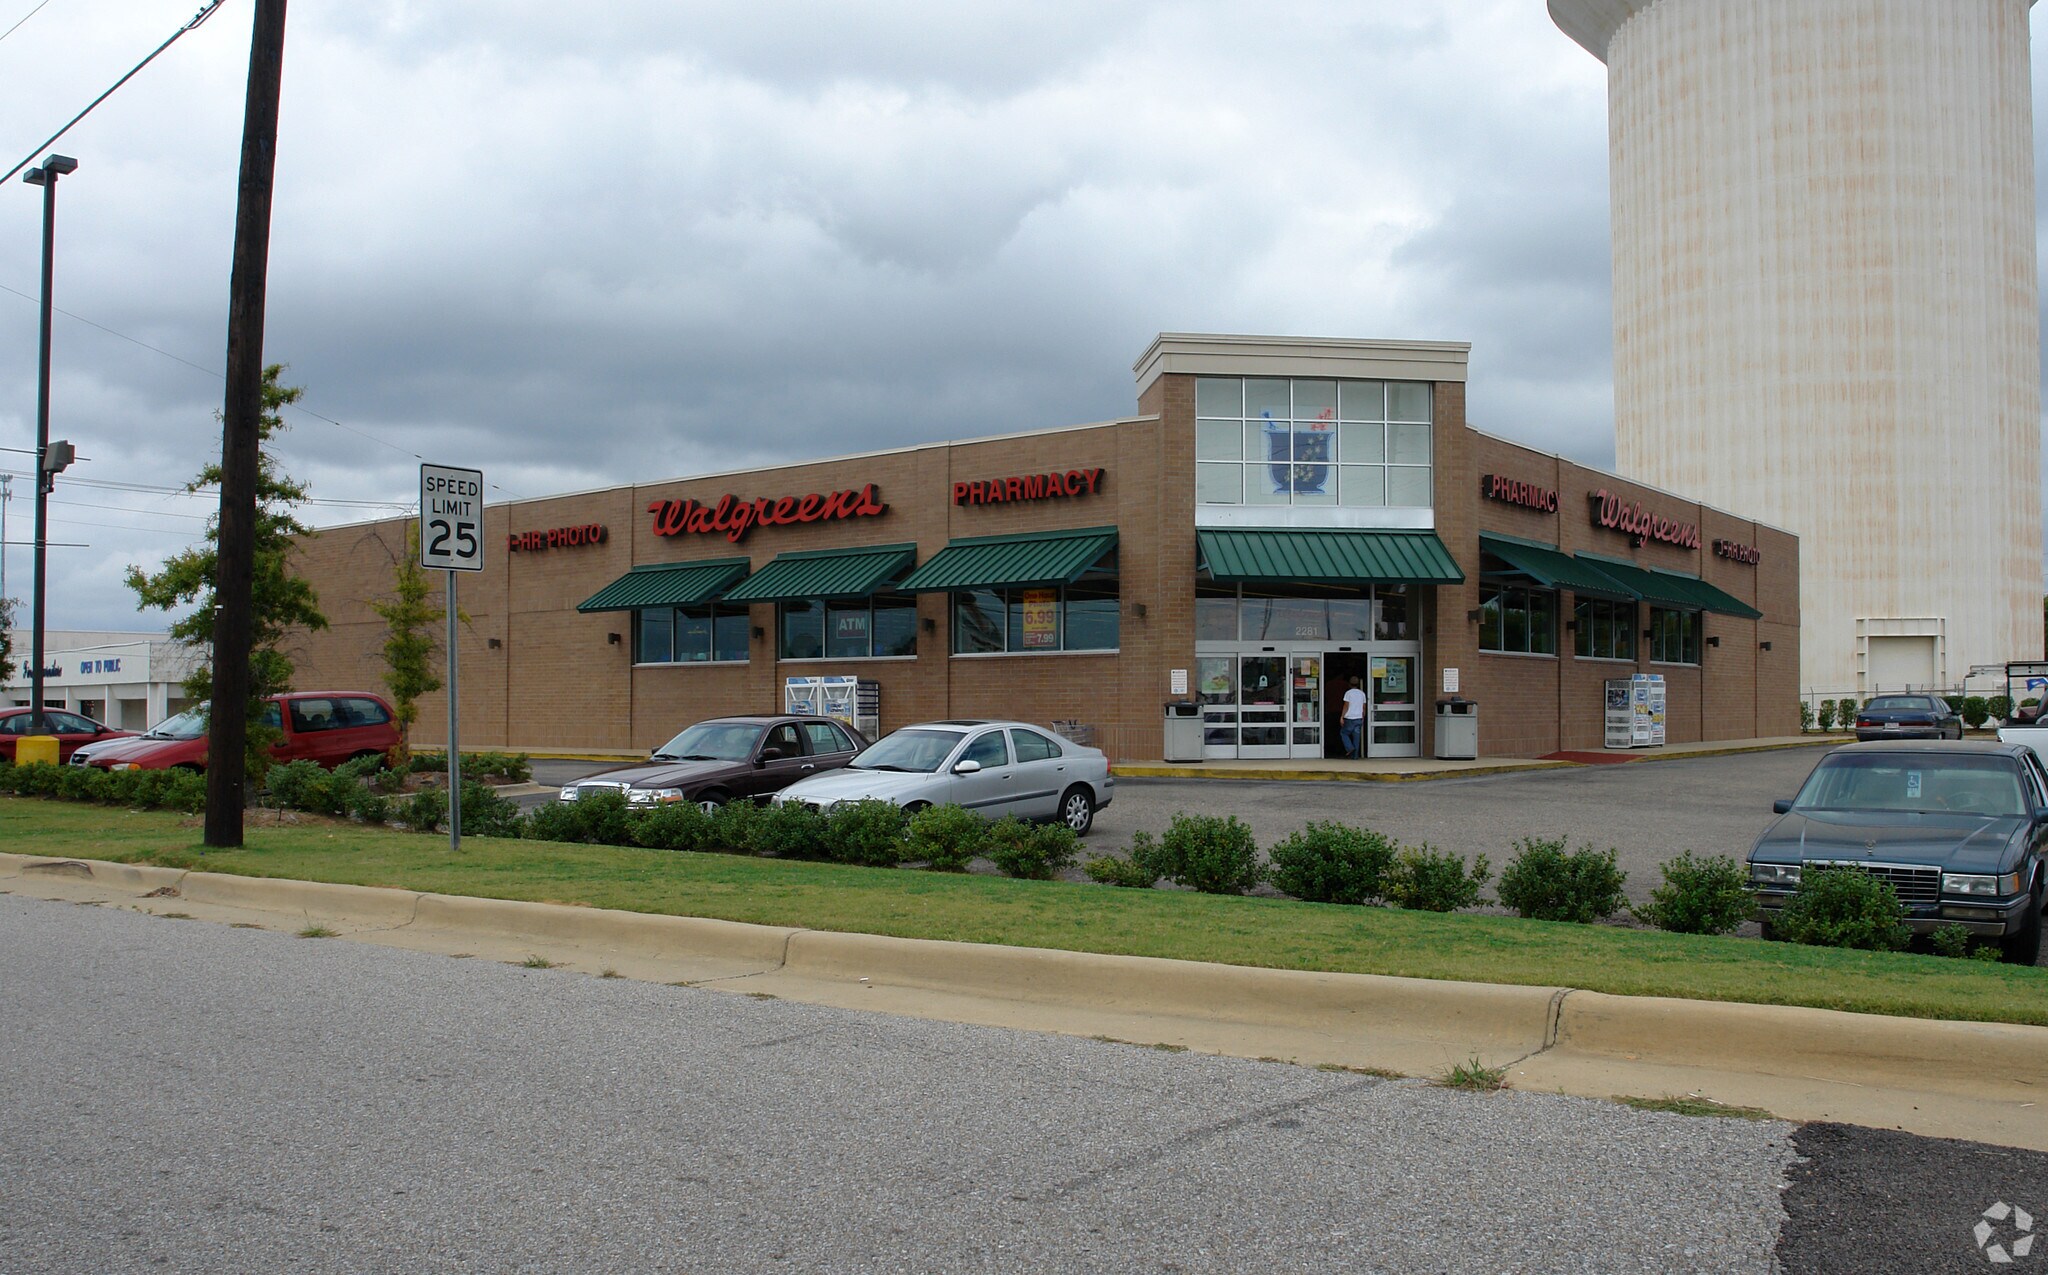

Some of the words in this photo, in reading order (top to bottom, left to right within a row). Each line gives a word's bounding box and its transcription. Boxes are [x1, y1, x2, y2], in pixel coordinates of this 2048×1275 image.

[426, 476, 478, 496] SPEED
[953, 467, 1103, 506] PHARMACY
[1492, 473, 1562, 513] PHARMACY
[432, 498, 471, 517] LIMIT
[647, 483, 885, 543] Walgreens
[1596, 489, 1702, 548] Walgreens
[429, 519, 478, 558] 25
[547, 523, 601, 548] PHOTO
[839, 617, 865, 630] ATM
[1025, 609, 1055, 625] 6.99
[1036, 633, 1054, 643] 7.99
[1296, 626, 1318, 636] 2281
